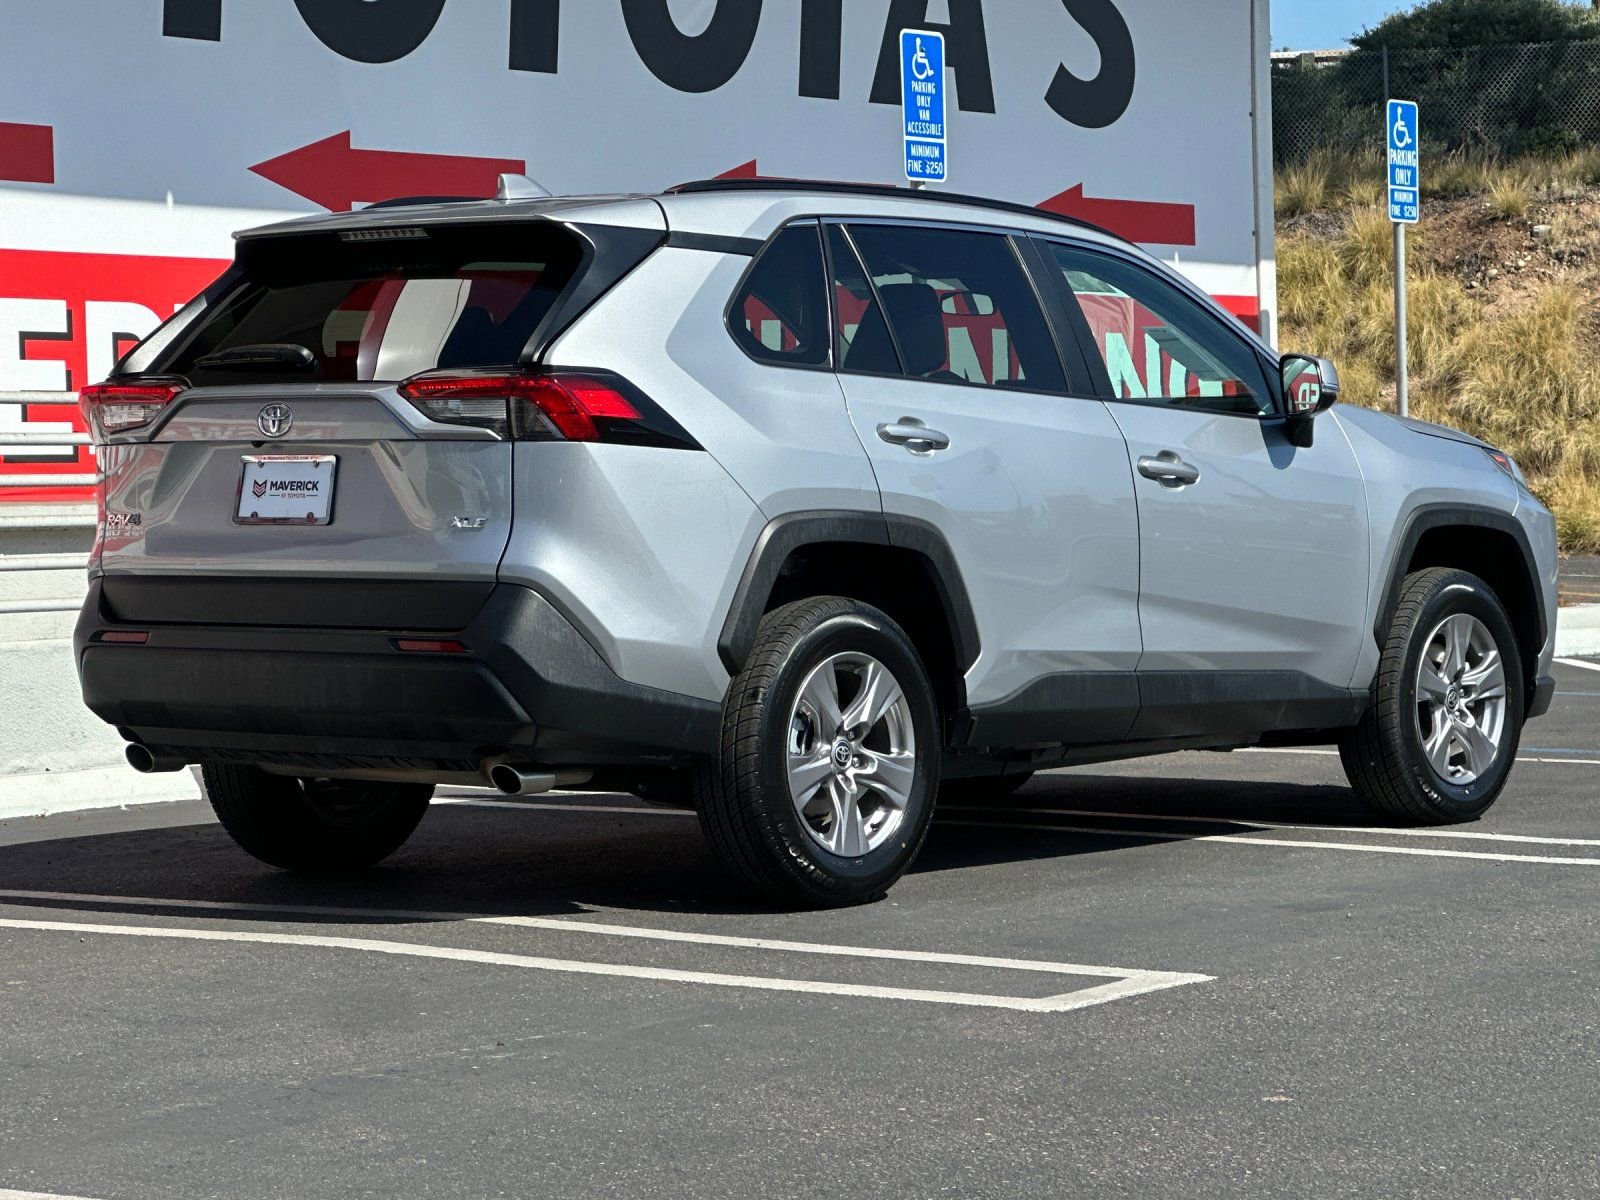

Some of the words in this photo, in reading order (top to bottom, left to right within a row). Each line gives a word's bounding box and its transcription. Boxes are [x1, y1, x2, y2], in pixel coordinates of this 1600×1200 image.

[911, 80, 936, 94] PARKING
[916, 94, 931, 108] ONLY
[918, 108, 930, 121] VAN
[907, 121, 942, 136] ACCESSIBLE
[910, 143, 940, 159] MINIMUM
[1390, 148, 1417, 168] PARKING
[907, 159, 923, 173] FINE
[925, 160, 944, 175] $250
[1395, 167, 1412, 186] ONLY
[269, 480, 319, 491] MAVERICK
[108, 513, 141, 526] RAV4
[450, 516, 488, 528] XLE
